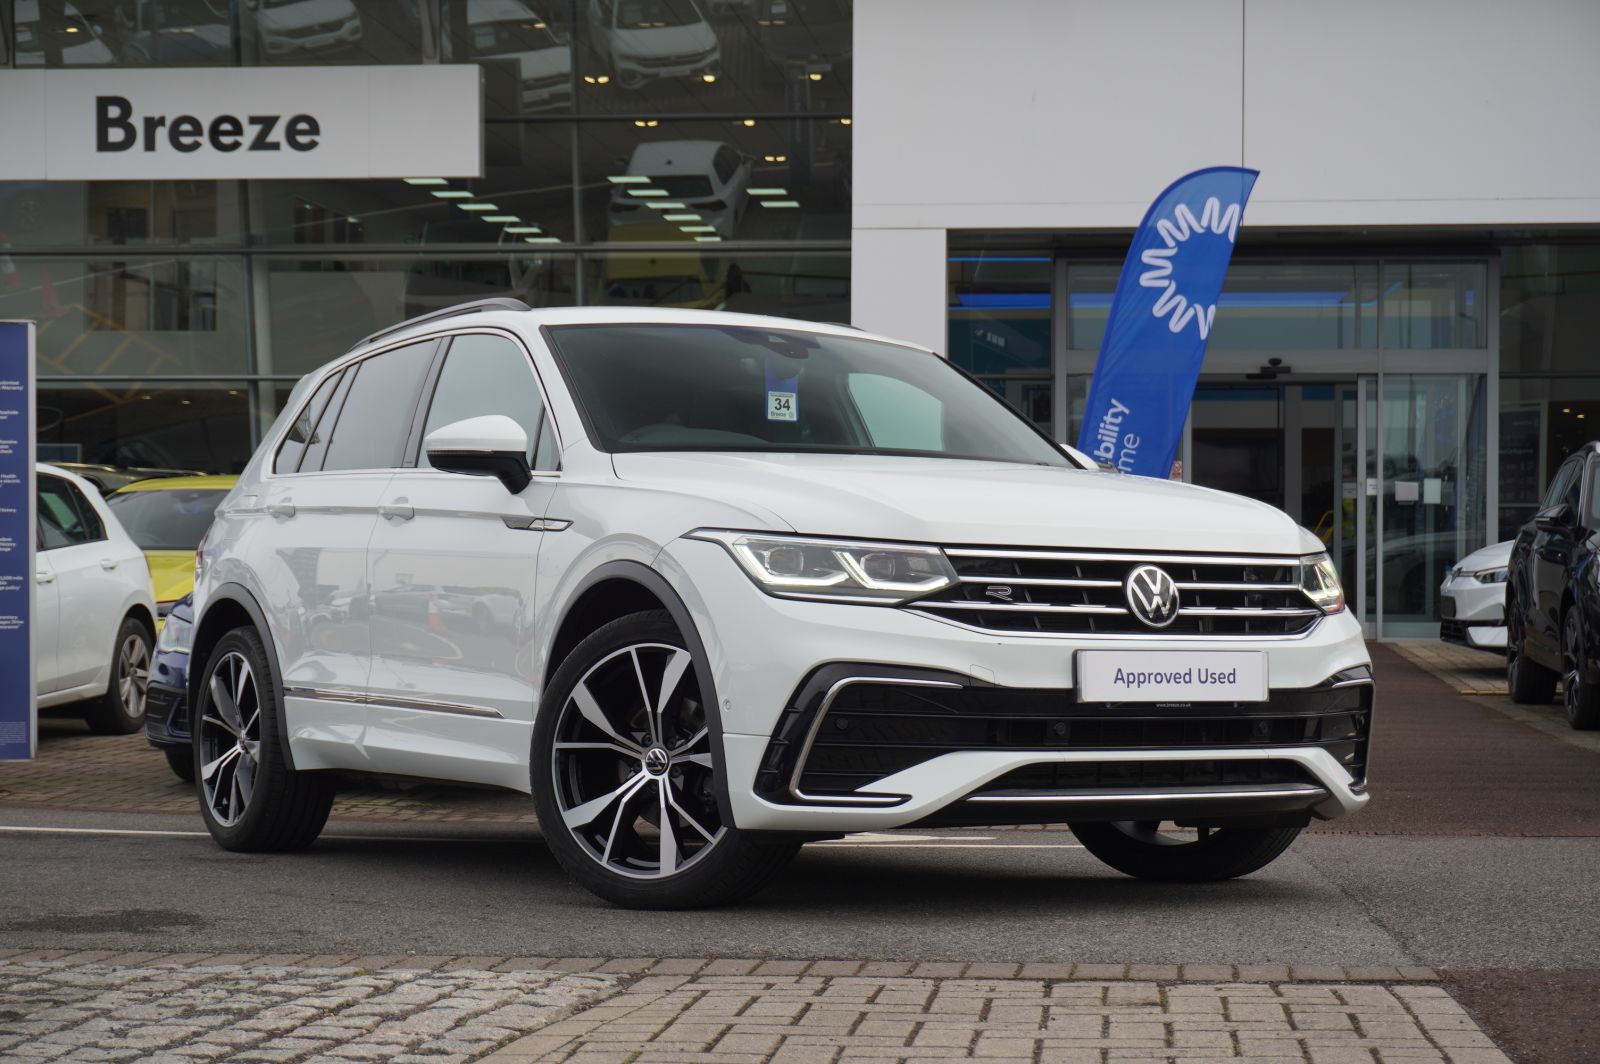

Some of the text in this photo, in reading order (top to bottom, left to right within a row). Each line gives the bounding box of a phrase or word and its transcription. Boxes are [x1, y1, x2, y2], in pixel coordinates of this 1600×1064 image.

[96, 95, 320, 152] Breeze
[774, 398, 790, 411] 34
[1094, 398, 1130, 464] bility
[1118, 433, 1140, 474] me
[1113, 667, 1236, 688] Approved Used
